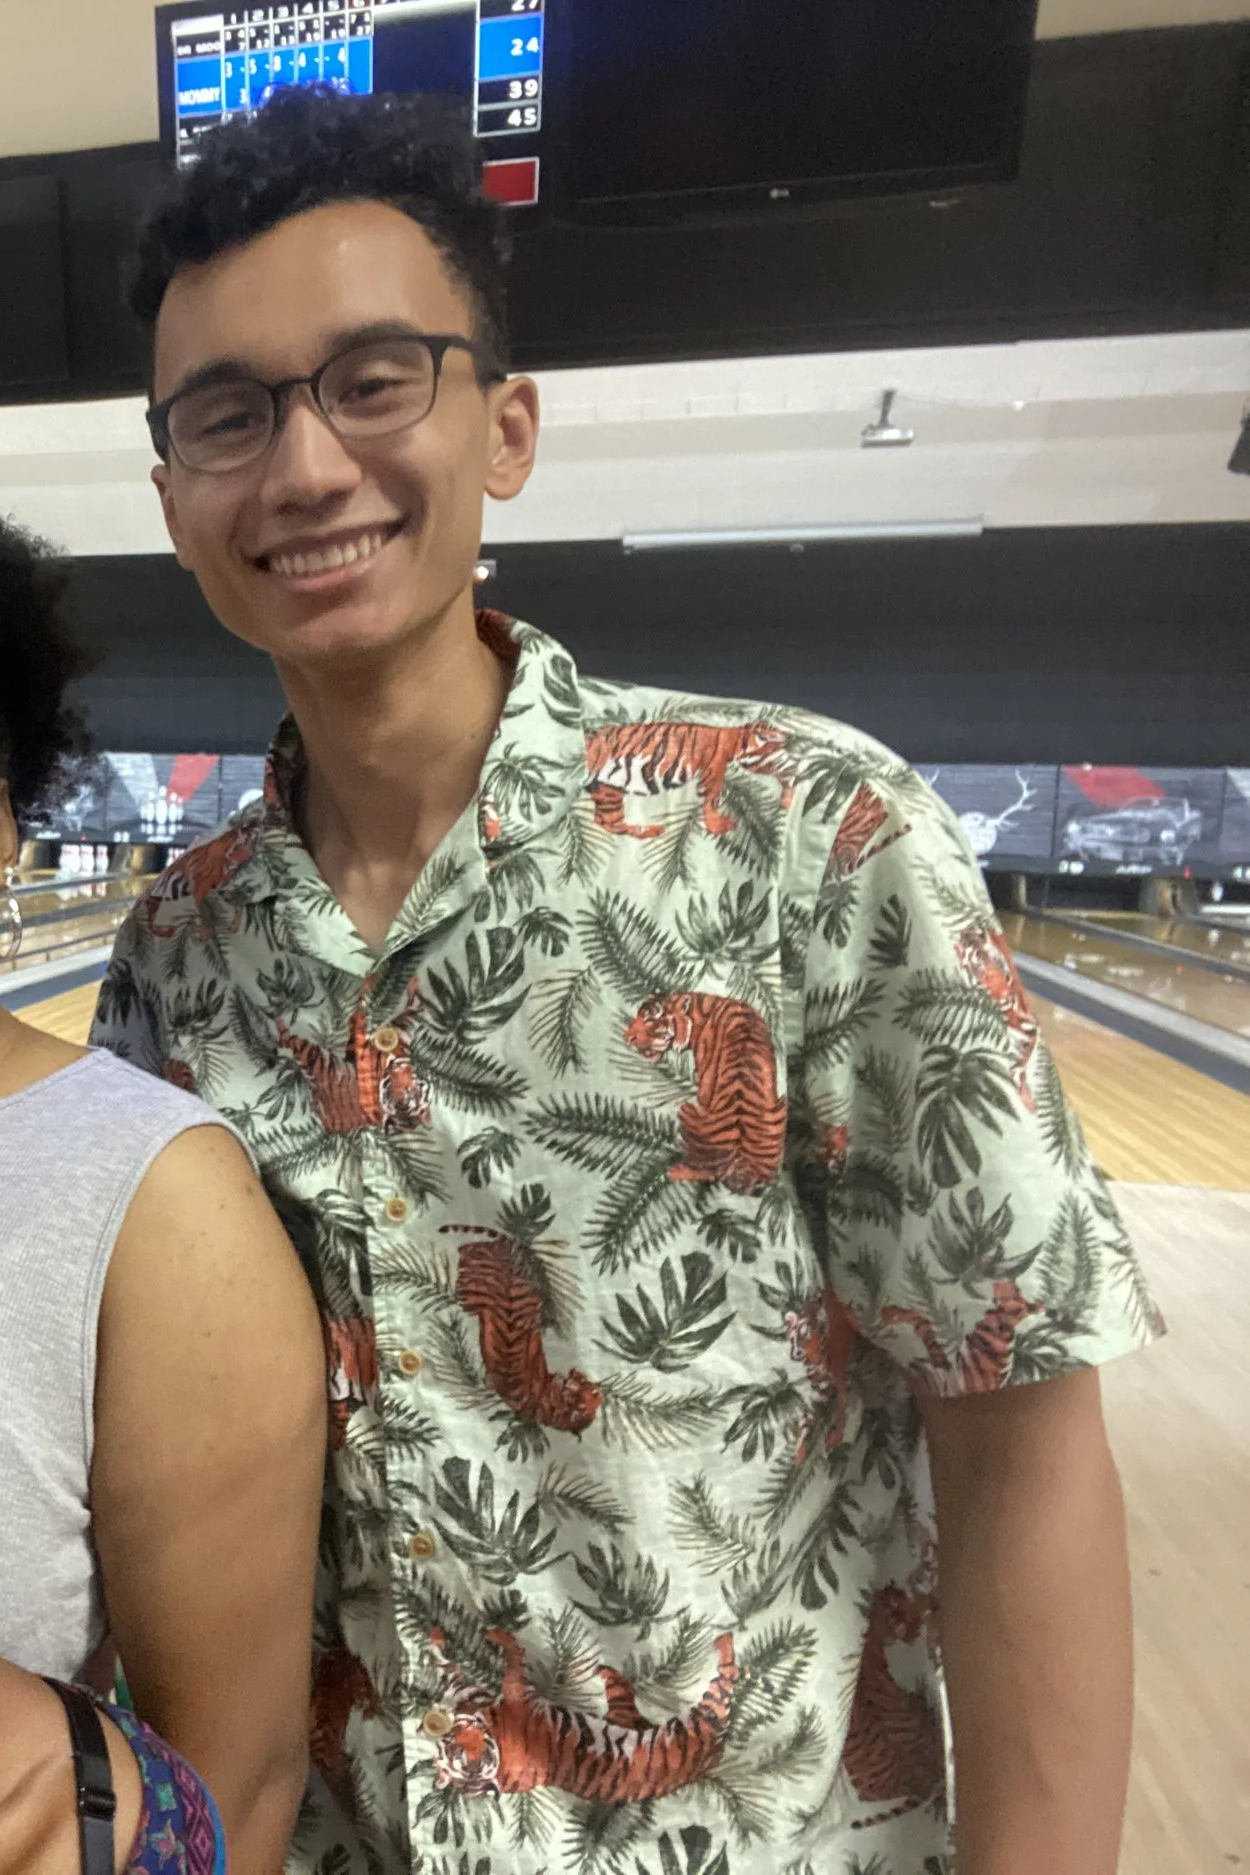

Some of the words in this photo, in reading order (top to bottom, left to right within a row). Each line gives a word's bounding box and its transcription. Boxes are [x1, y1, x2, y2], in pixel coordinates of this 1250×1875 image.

[510, 37, 539, 56] 24
[509, 79, 538, 99] 39
[507, 107, 537, 127] 45
